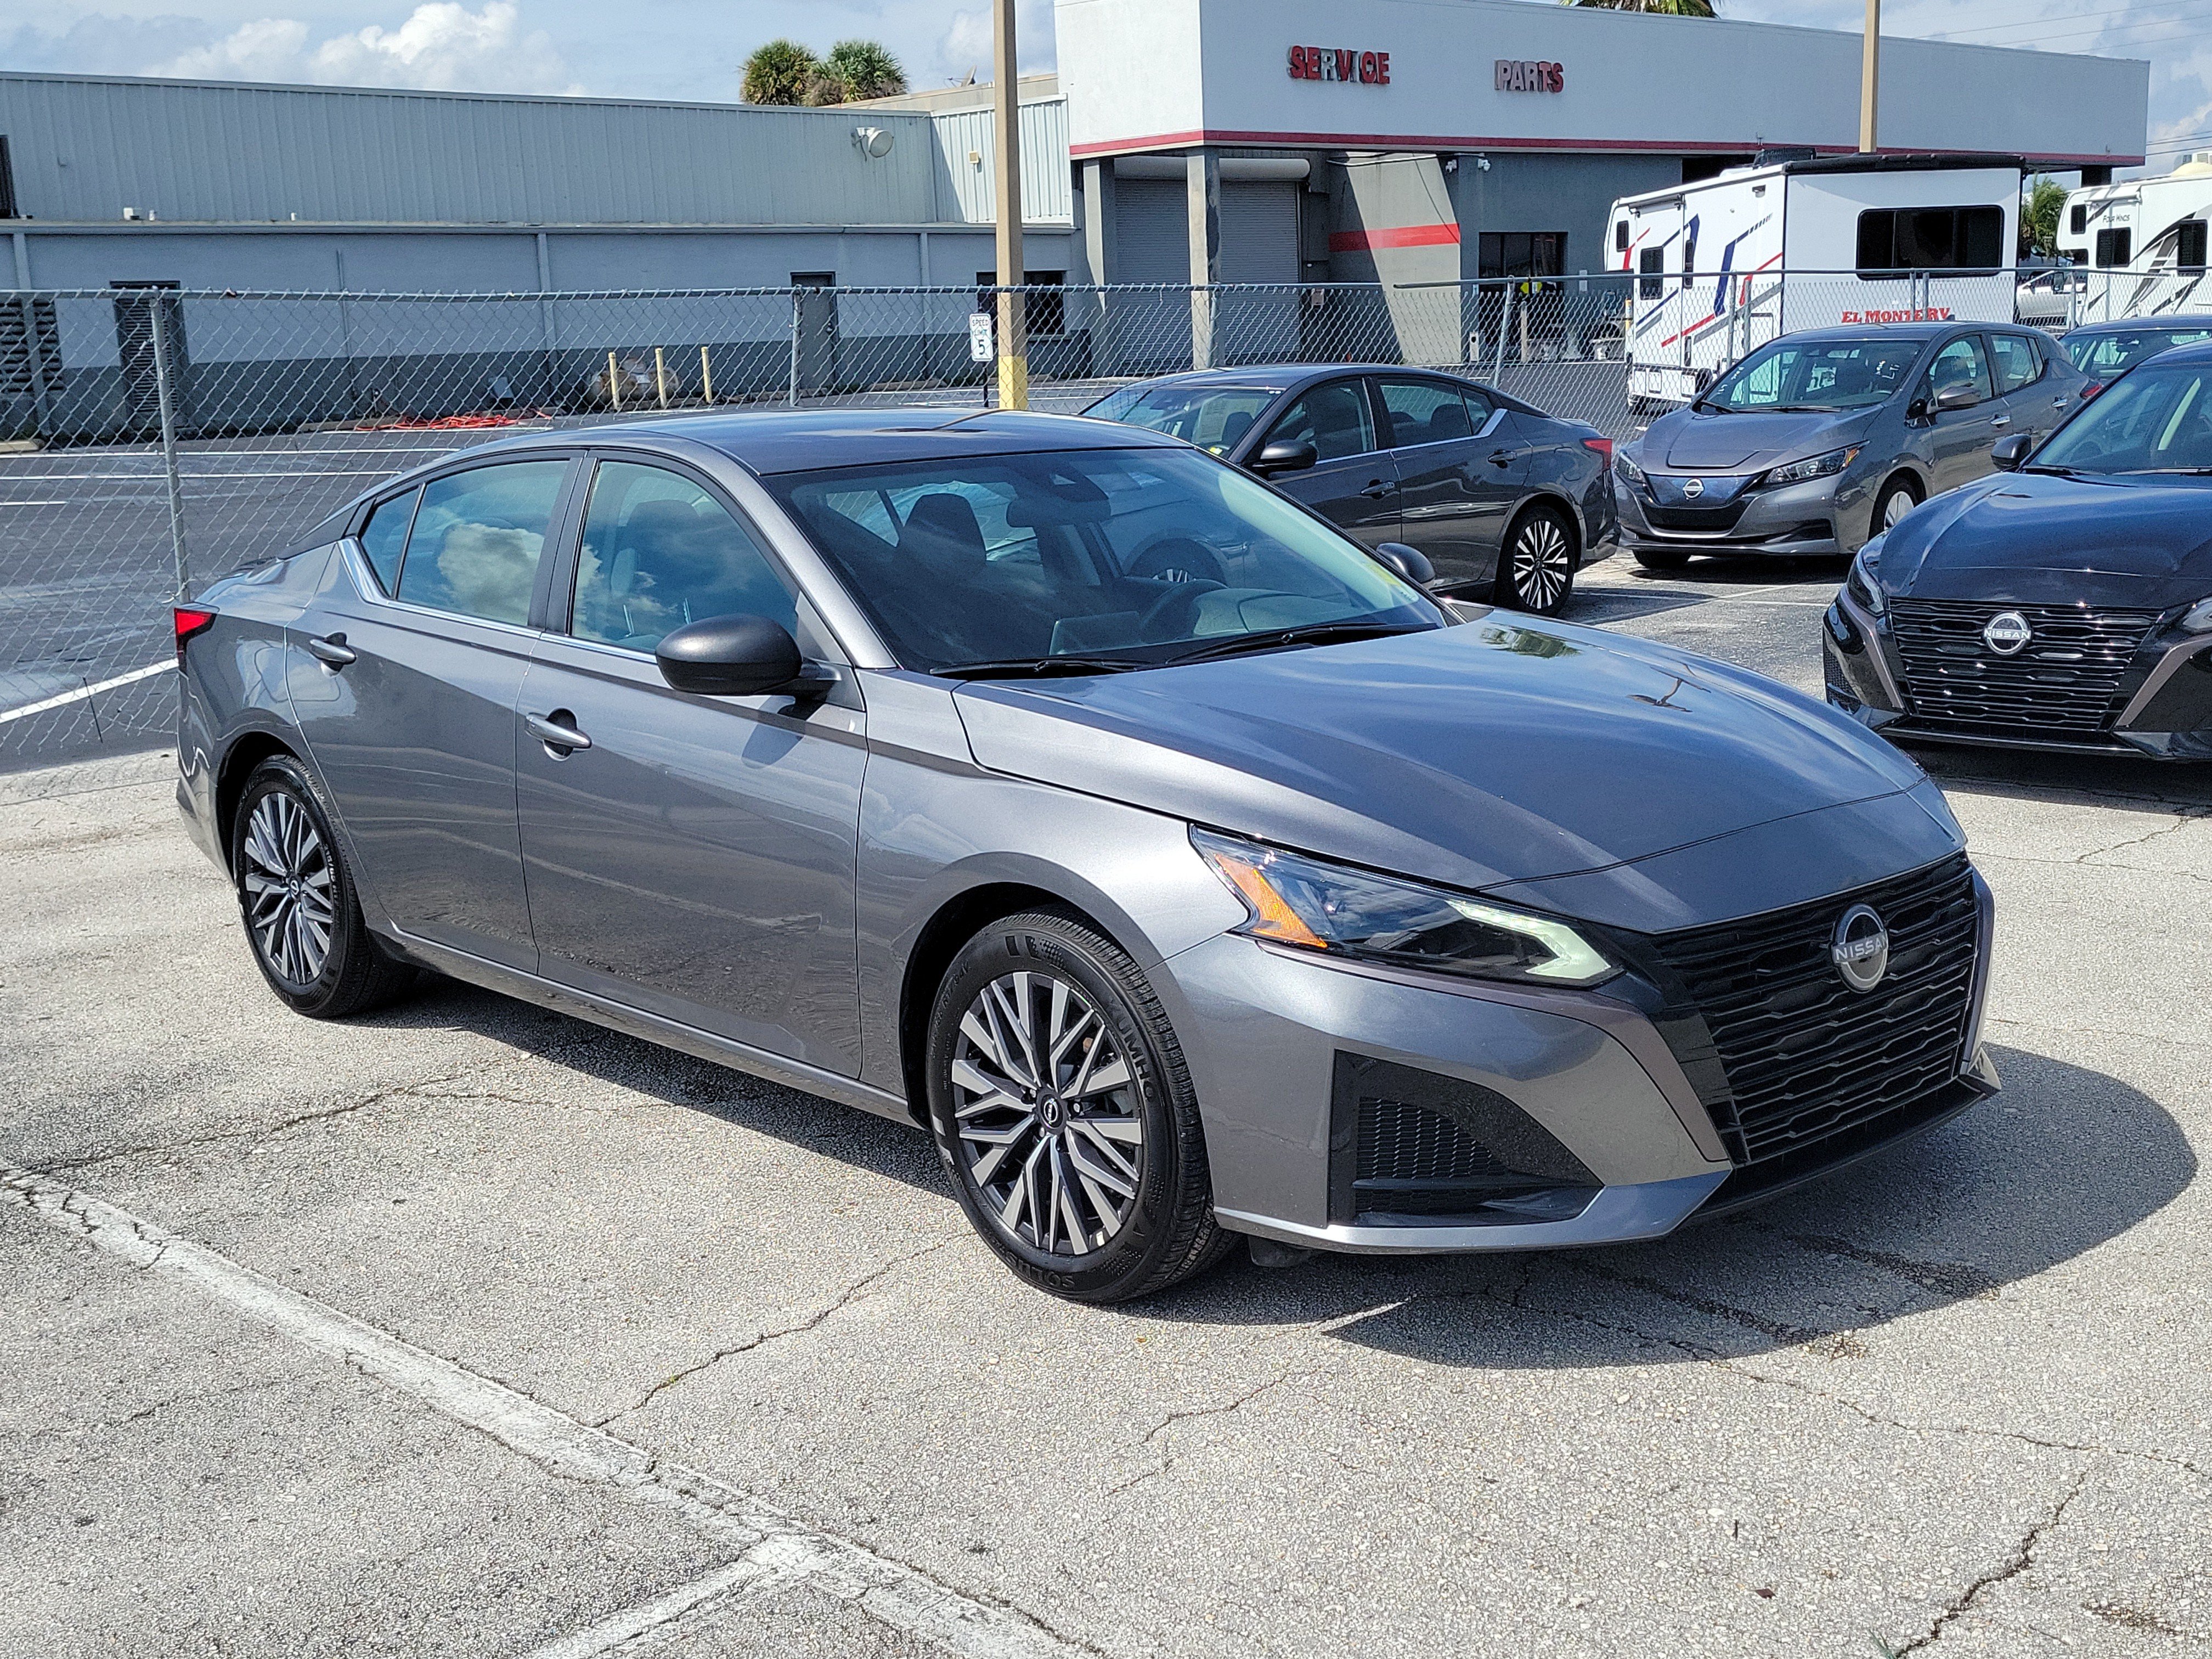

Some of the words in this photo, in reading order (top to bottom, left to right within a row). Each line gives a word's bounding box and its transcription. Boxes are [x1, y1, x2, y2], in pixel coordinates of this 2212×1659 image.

[1286, 46, 1390, 84] SERVICE
[1494, 60, 1564, 93] PARTS
[1841, 311, 1862, 323] EL
[1865, 309, 1923, 323] MONTE
[1926, 307, 1951, 320] RV
[978, 339, 985, 356] 5
[1984, 629, 2030, 640] NISSAN
[1835, 934, 1887, 961] NISSAN
[1104, 995, 1153, 1101] KUMHO
